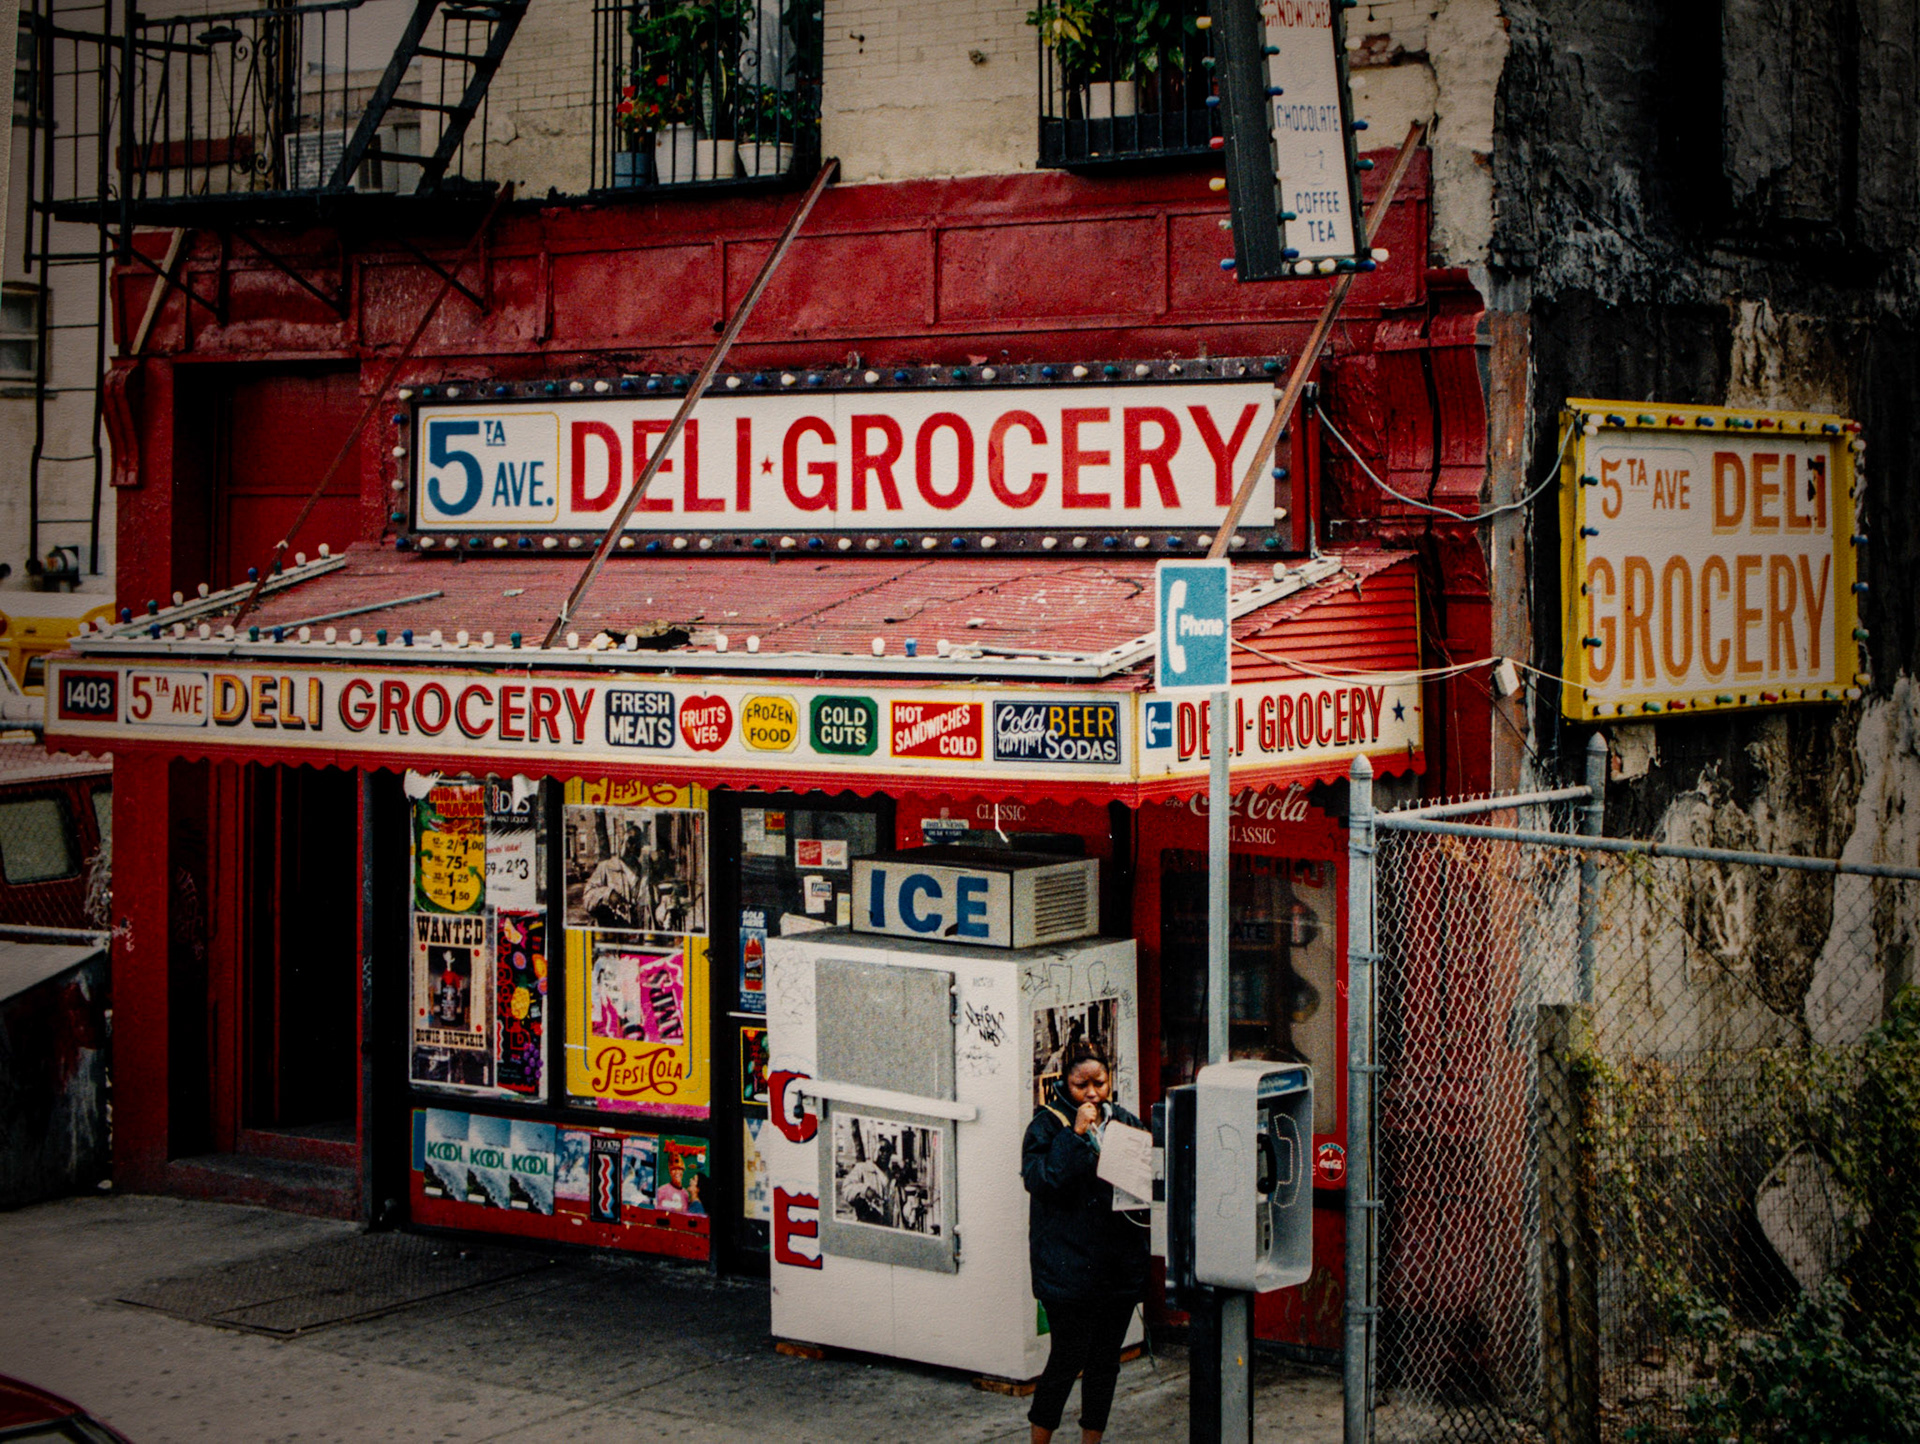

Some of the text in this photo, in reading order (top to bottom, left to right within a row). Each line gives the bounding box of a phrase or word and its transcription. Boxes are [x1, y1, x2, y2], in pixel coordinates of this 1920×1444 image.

[1276, 104, 1339, 132] CHOCOLATE
[1296, 191, 1340, 214] COFFEE
[1307, 220, 1336, 242] TEA
[492, 461, 555, 507] AVE.
[570, 417, 752, 513] DELI
[782, 403, 1261, 513] GROCERY
[1653, 469, 1690, 510] AVE
[1711, 451, 1827, 535] DELI
[1179, 614, 1224, 637] Phone
[1586, 553, 1831, 688] GROCERY
[67, 680, 111, 709] 1403
[610, 691, 670, 715] FRESH
[172, 684, 203, 714] AVE
[213, 673, 324, 731] DELI
[339, 678, 596, 745] GROCERY
[681, 705, 727, 728] FRUITS
[746, 703, 793, 725] FROZEN
[820, 705, 867, 727] COLD
[894, 705, 924, 723] HOT
[1049, 706, 1115, 738] BEER
[1259, 685, 1385, 753] GROCERY
[608, 714, 672, 746] MEATS
[692, 727, 722, 745] VEG.
[750, 727, 791, 743] FOOD
[820, 725, 868, 746] CUTS
[894, 704, 971, 753] SANDWICHES
[939, 735, 977, 756] COLD
[1045, 729, 1118, 761] SODAS
[869, 868, 990, 938] ICE
[416, 915, 485, 946] WANTED
[426, 1141, 553, 1177] KOOL KOOL KOOL
